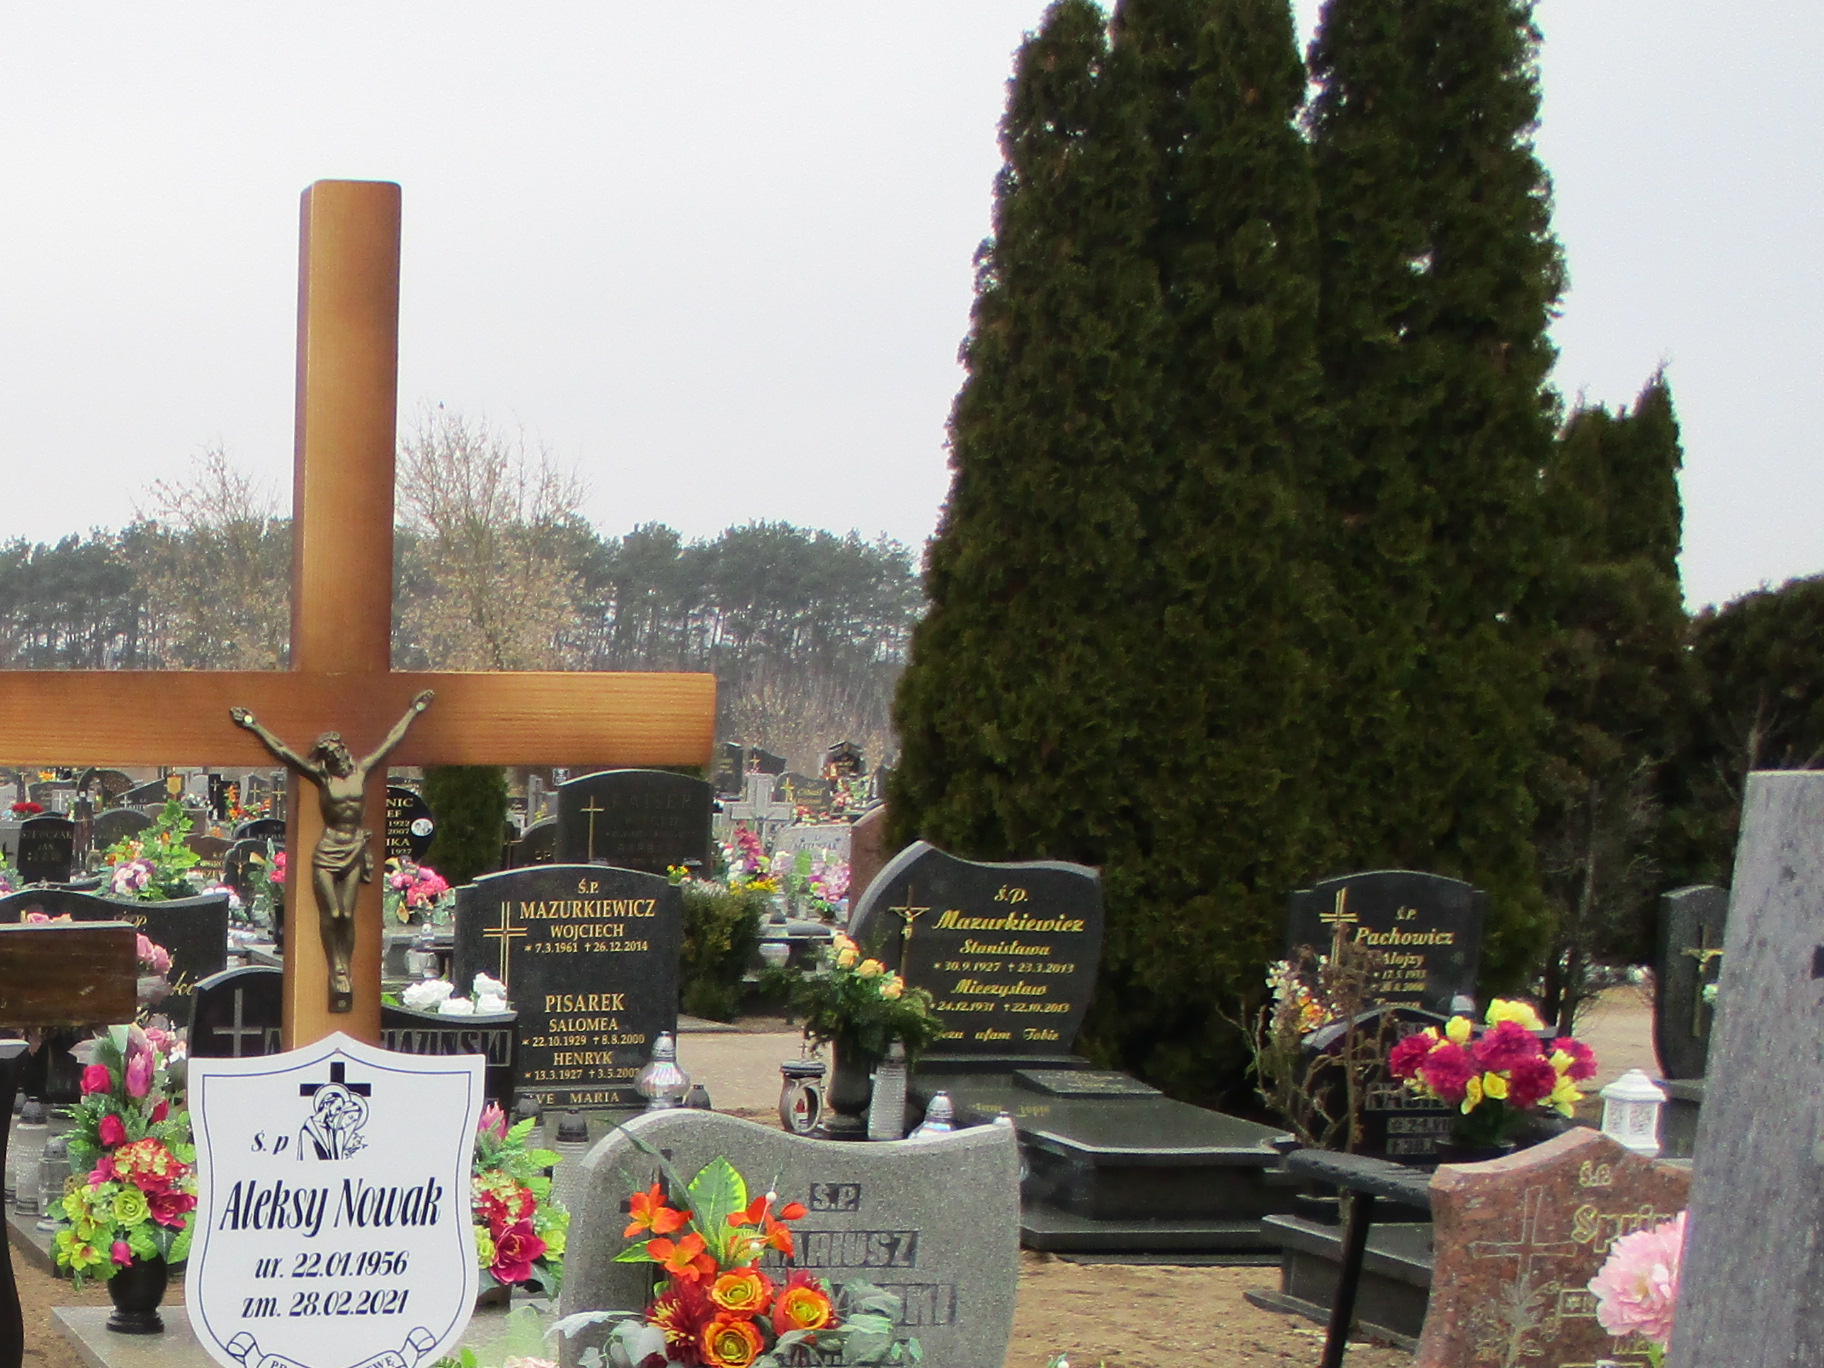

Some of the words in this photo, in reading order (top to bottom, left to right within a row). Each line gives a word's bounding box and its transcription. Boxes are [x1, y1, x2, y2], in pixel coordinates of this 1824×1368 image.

[386, 798, 413, 807] NIC
[520, 899, 656, 919] MAZURKIEWICZ
[931, 910, 1085, 931] Mazurkiewicz
[551, 924, 625, 941] WOJCIECH
[1354, 927, 1455, 945] Pachowicz
[535, 943, 578, 953] 7.3.1961
[593, 941, 649, 953] 26.12.2014
[544, 994, 625, 1013] PISAREK
[549, 1018, 619, 1032] SALOMEA
[532, 1035, 586, 1047] 22.10.1929
[601, 1034, 645, 1045] 8.8.2000
[553, 1051, 614, 1065] HENRYK
[534, 1069, 583, 1080] 13.3.1927
[535, 1093, 555, 1104] VE
[569, 1092, 620, 1103] MARIA
[219, 1180, 329, 1237] Aleksy
[333, 1177, 443, 1228] Nowak
[254, 1257, 285, 1279] ur.
[291, 1250, 410, 1278] 22.01.1956
[241, 1296, 282, 1318] zm.
[288, 1289, 410, 1317] 28.02.2021
